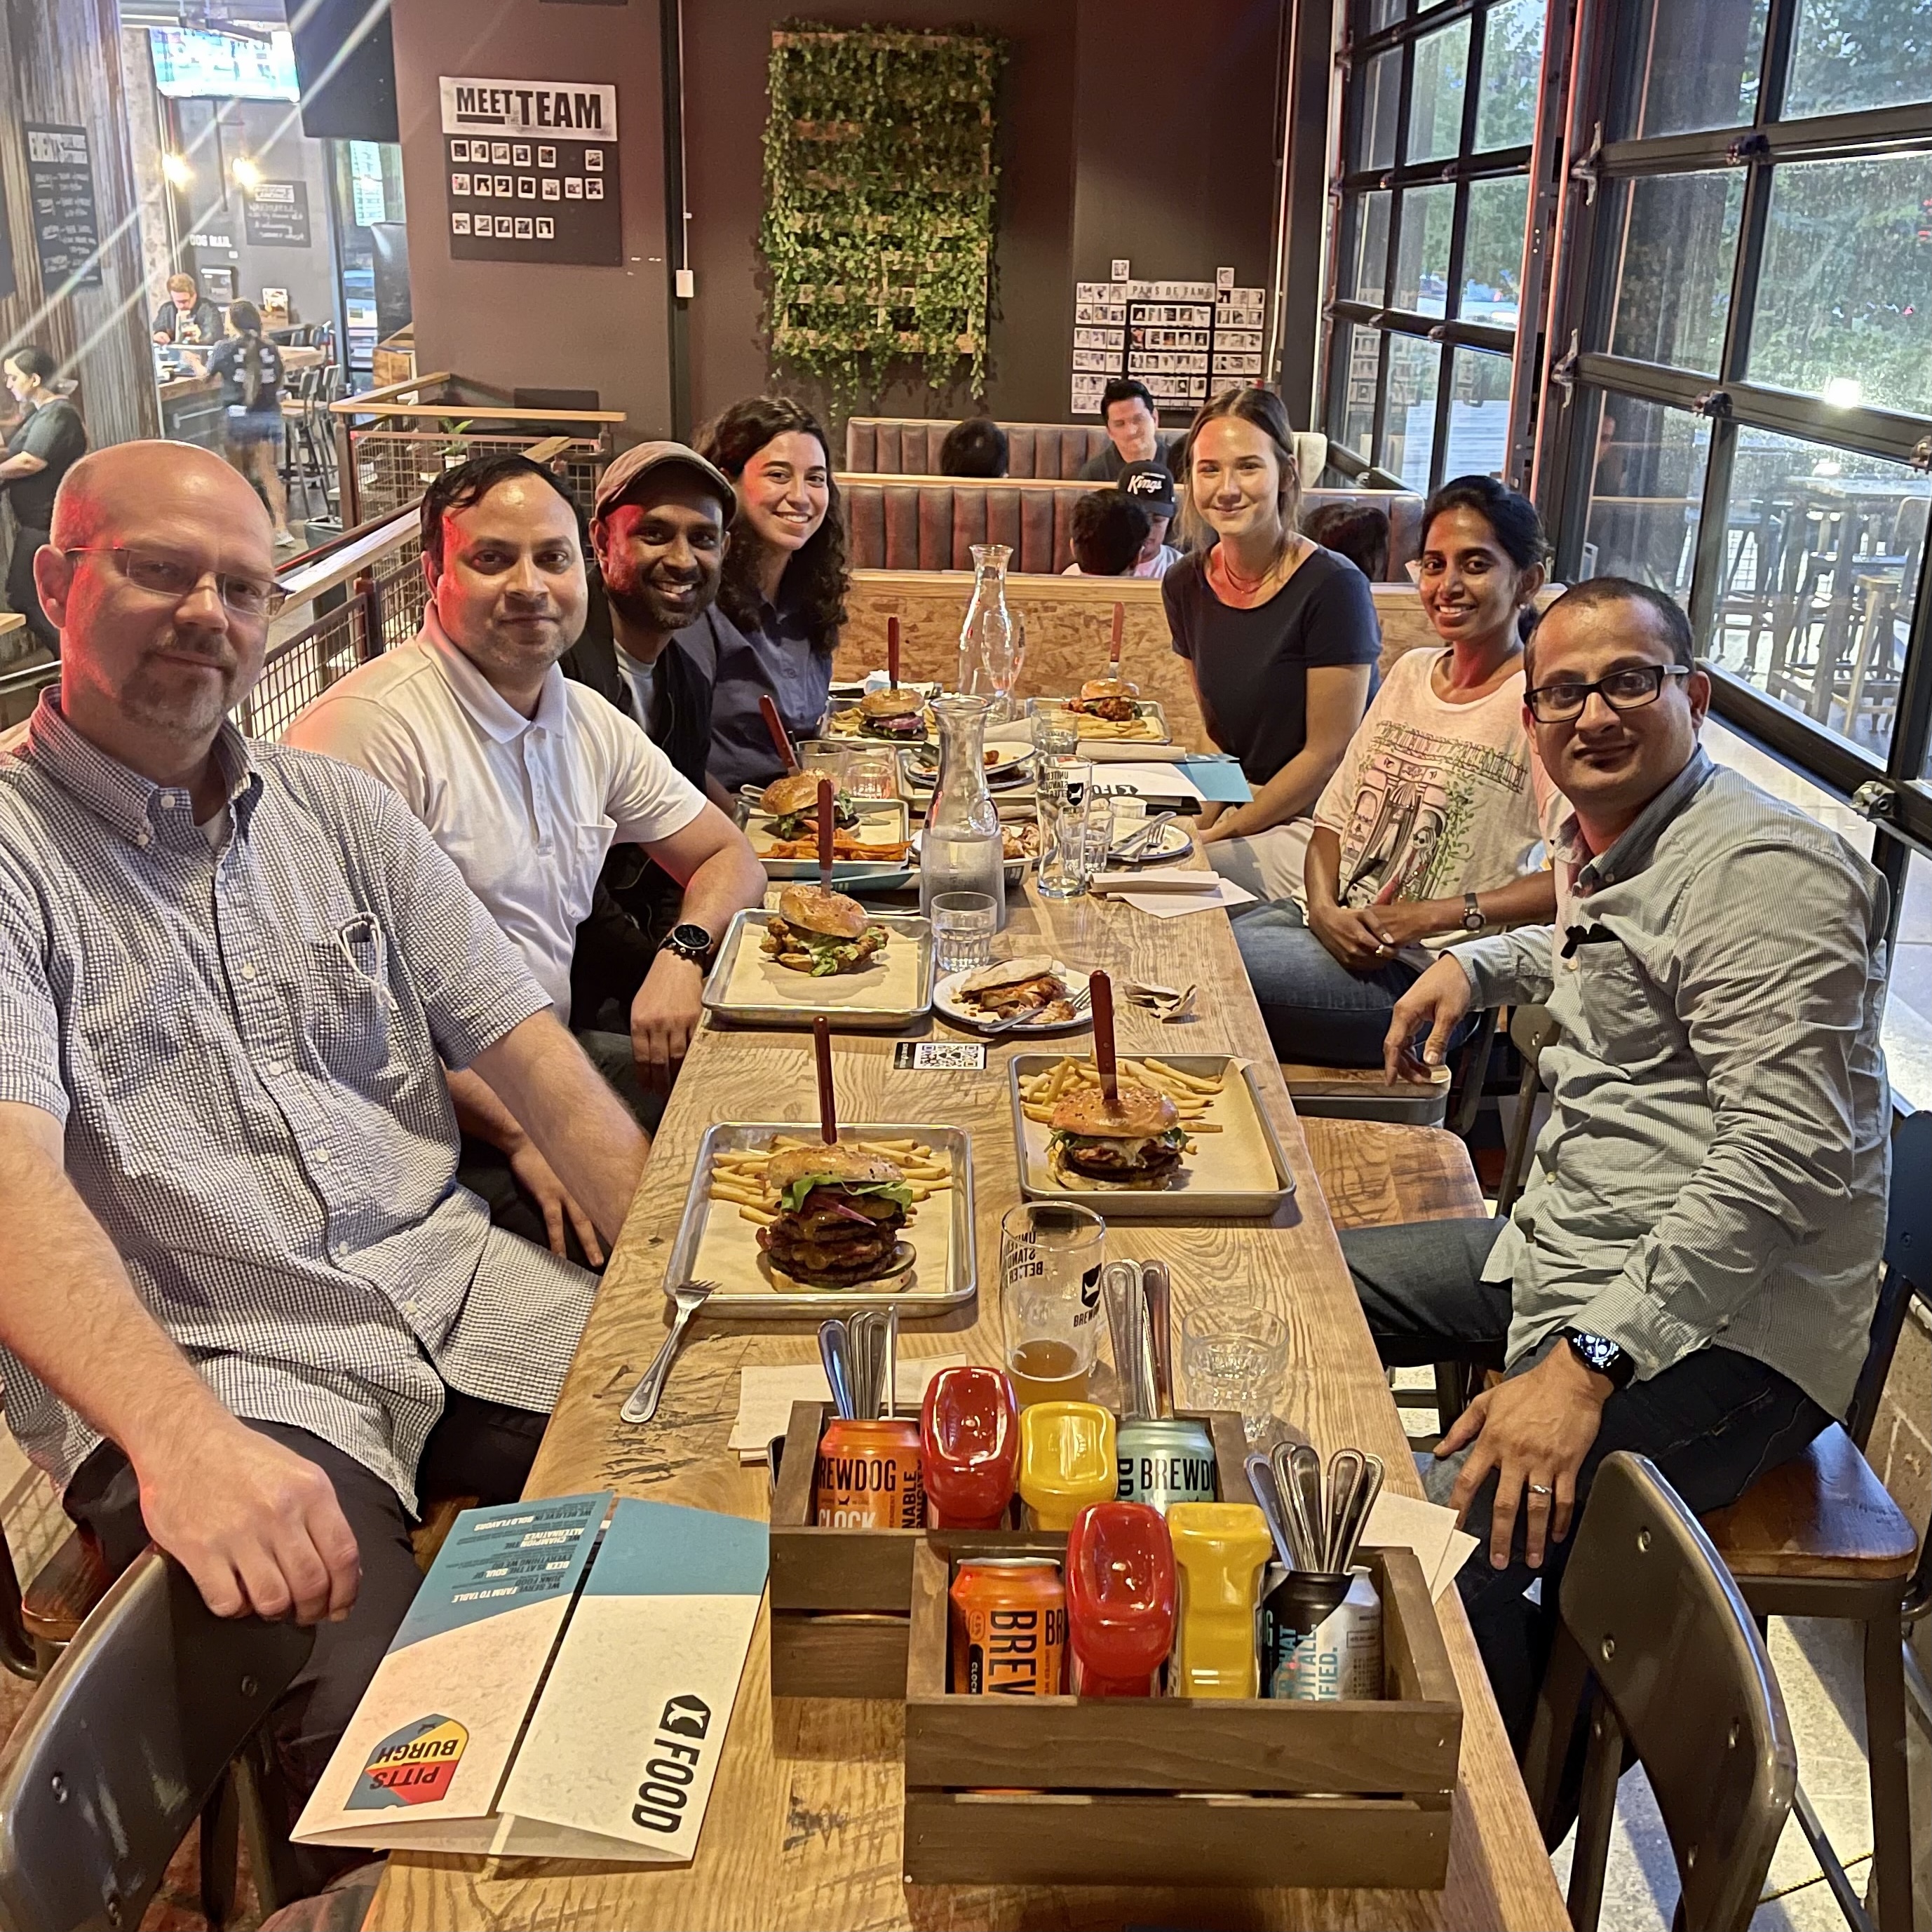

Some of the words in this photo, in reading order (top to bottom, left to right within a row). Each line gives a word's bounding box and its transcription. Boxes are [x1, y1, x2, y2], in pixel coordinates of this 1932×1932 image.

[456, 87, 513, 114] MEET
[515, 90, 602, 129] TEAM
[1132, 285, 1160, 295] PAWS
[1166, 286, 1178, 295] OF
[1183, 286, 1212, 297] FAME
[1127, 475, 1163, 494] Kings
[1073, 1299, 1101, 1328] BREW
[520, 1536, 567, 1548] CHAMPION
[485, 1568, 508, 1578] SOUL
[480, 1590, 492, 1598] TO
[492, 1586, 518, 1596] FARM
[375, 1739, 459, 1764] BURGH
[370, 1766, 440, 1790] PITTS
[631, 1738, 701, 1833] FOOD
